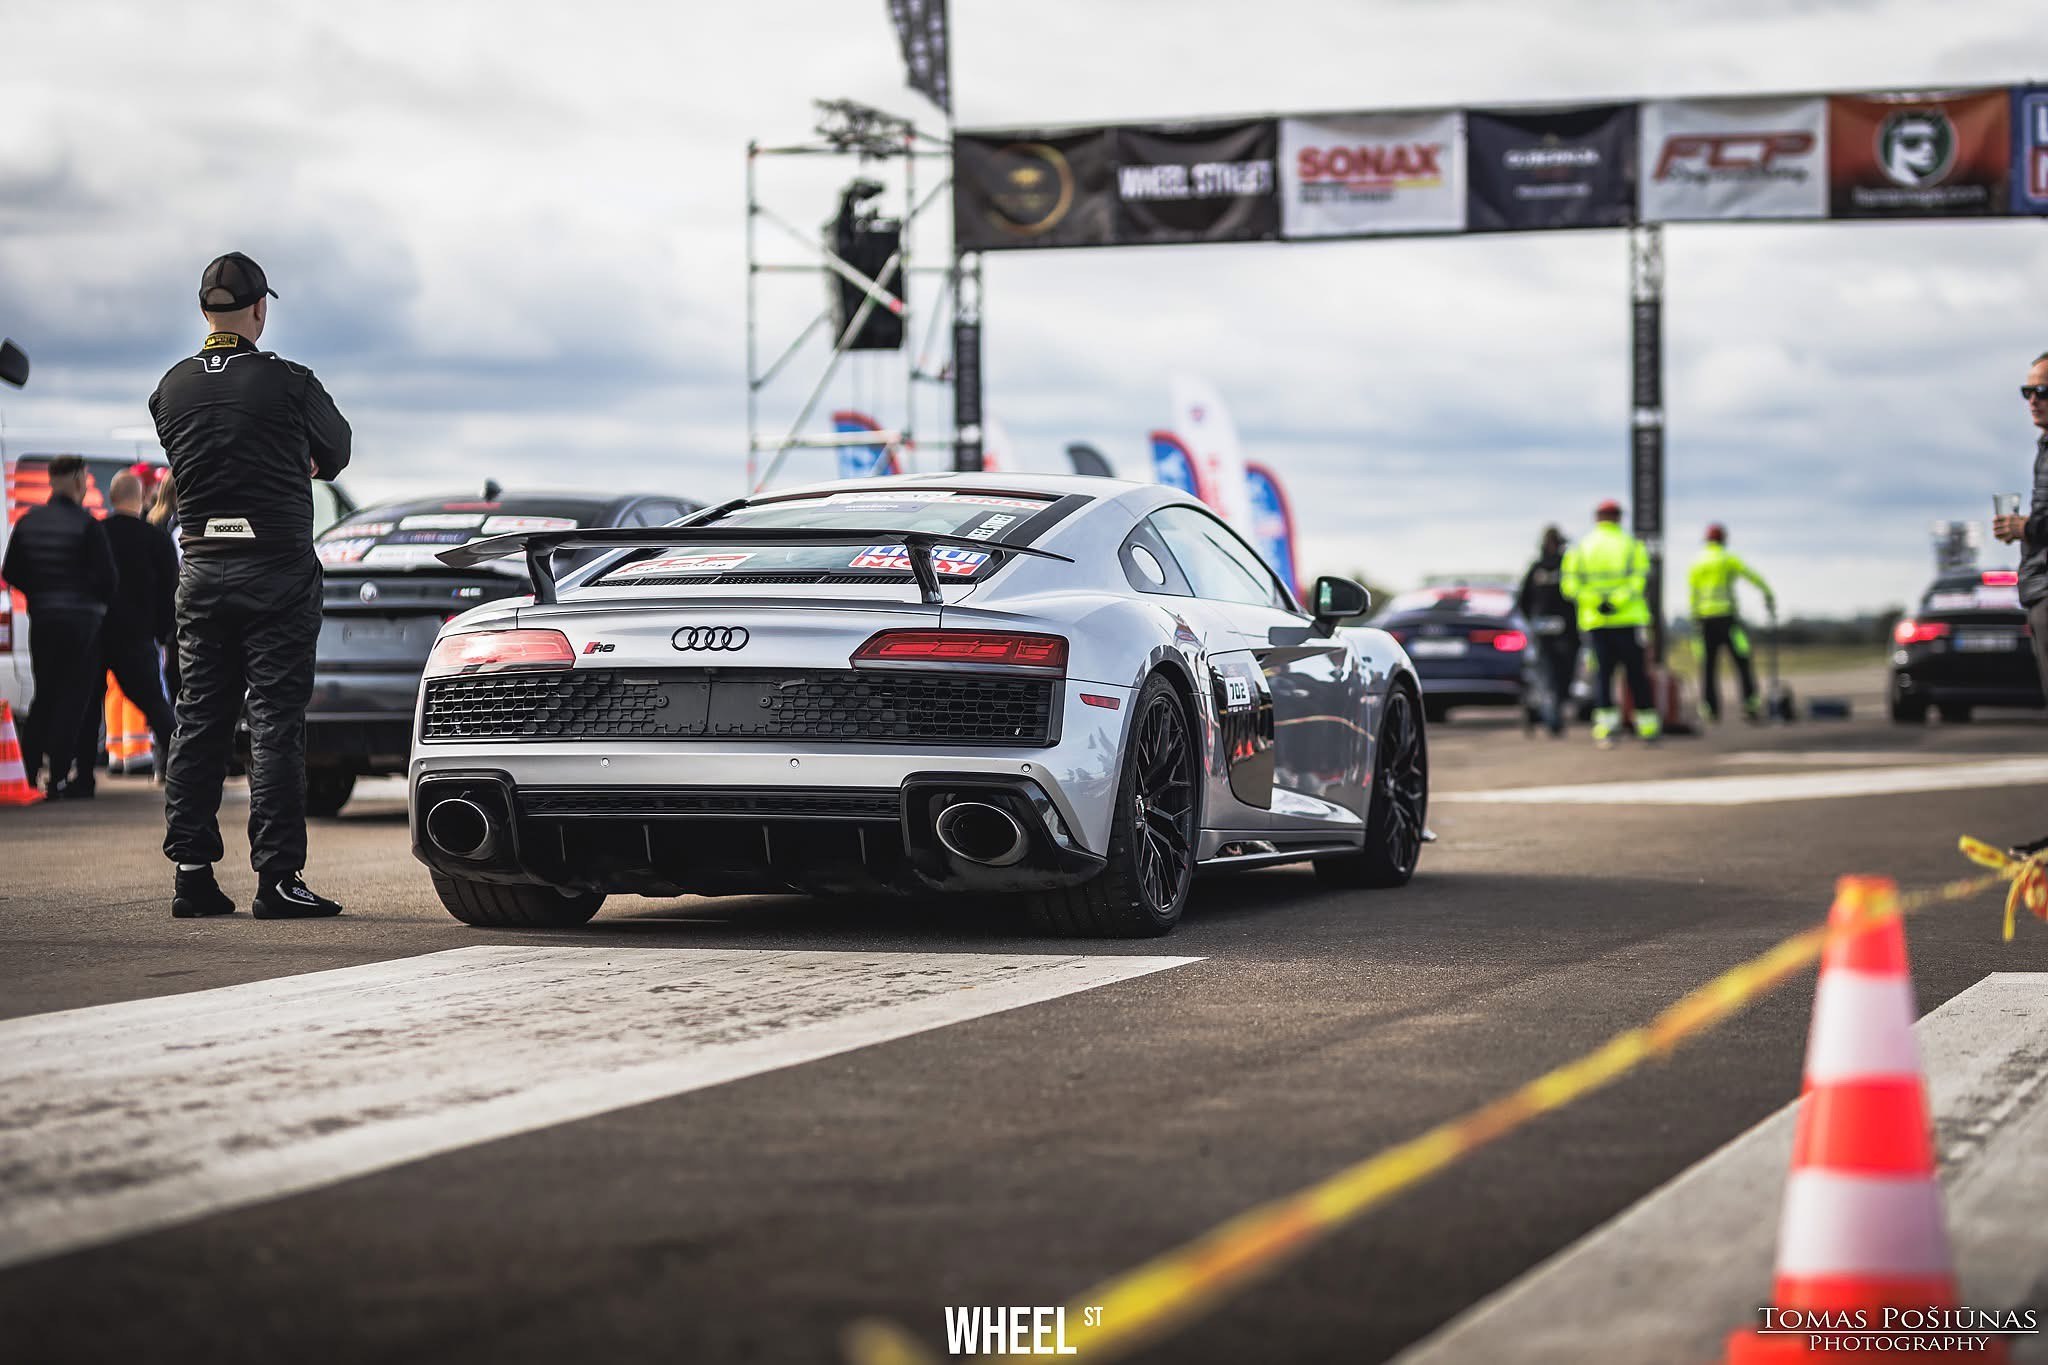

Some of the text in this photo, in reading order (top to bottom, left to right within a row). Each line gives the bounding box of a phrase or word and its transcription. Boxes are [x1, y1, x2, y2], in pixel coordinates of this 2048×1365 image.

[1297, 144, 1441, 182] SONAX
[590, 642, 616, 654] R8
[1229, 683, 1246, 700] 702
